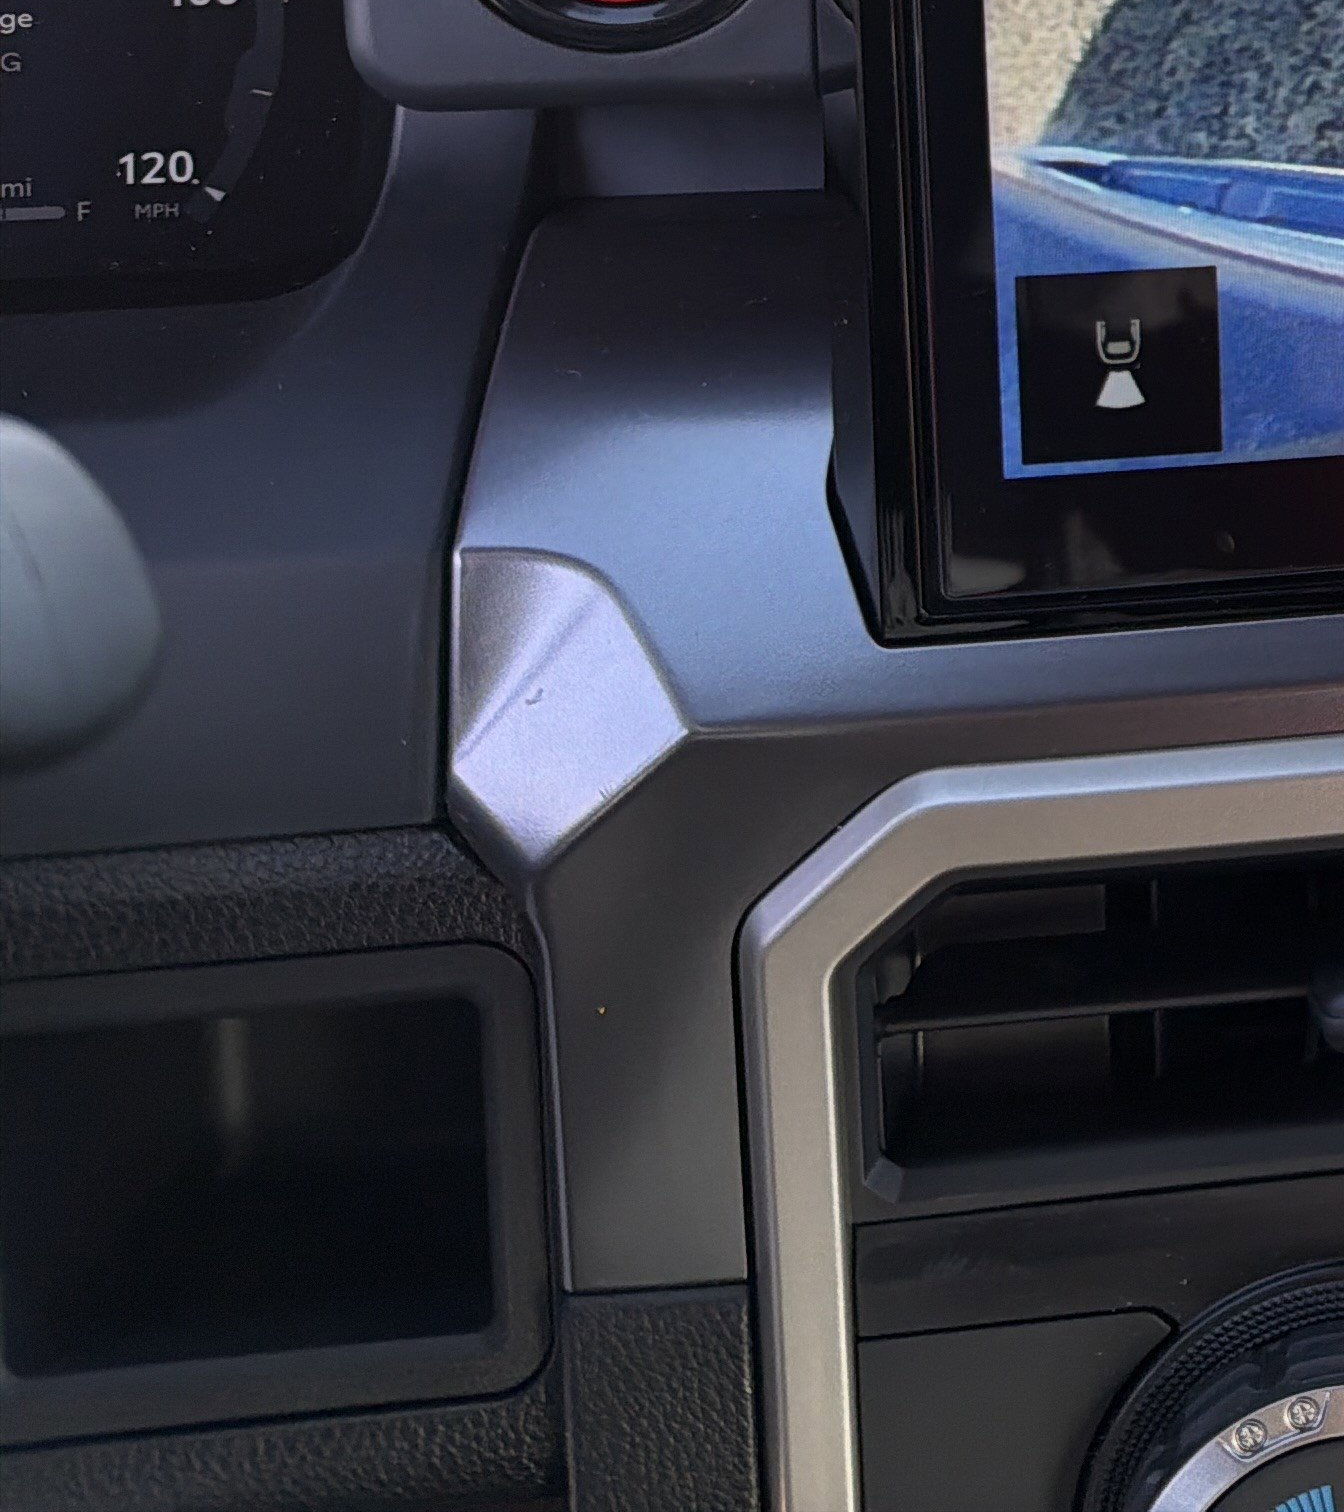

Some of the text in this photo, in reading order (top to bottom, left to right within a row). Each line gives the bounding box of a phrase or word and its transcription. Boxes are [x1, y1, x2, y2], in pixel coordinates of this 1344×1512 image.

[118, 150, 194, 185] 120
[0, 177, 32, 197] mi
[77, 201, 92, 222] F
[134, 203, 180, 219] MPH
